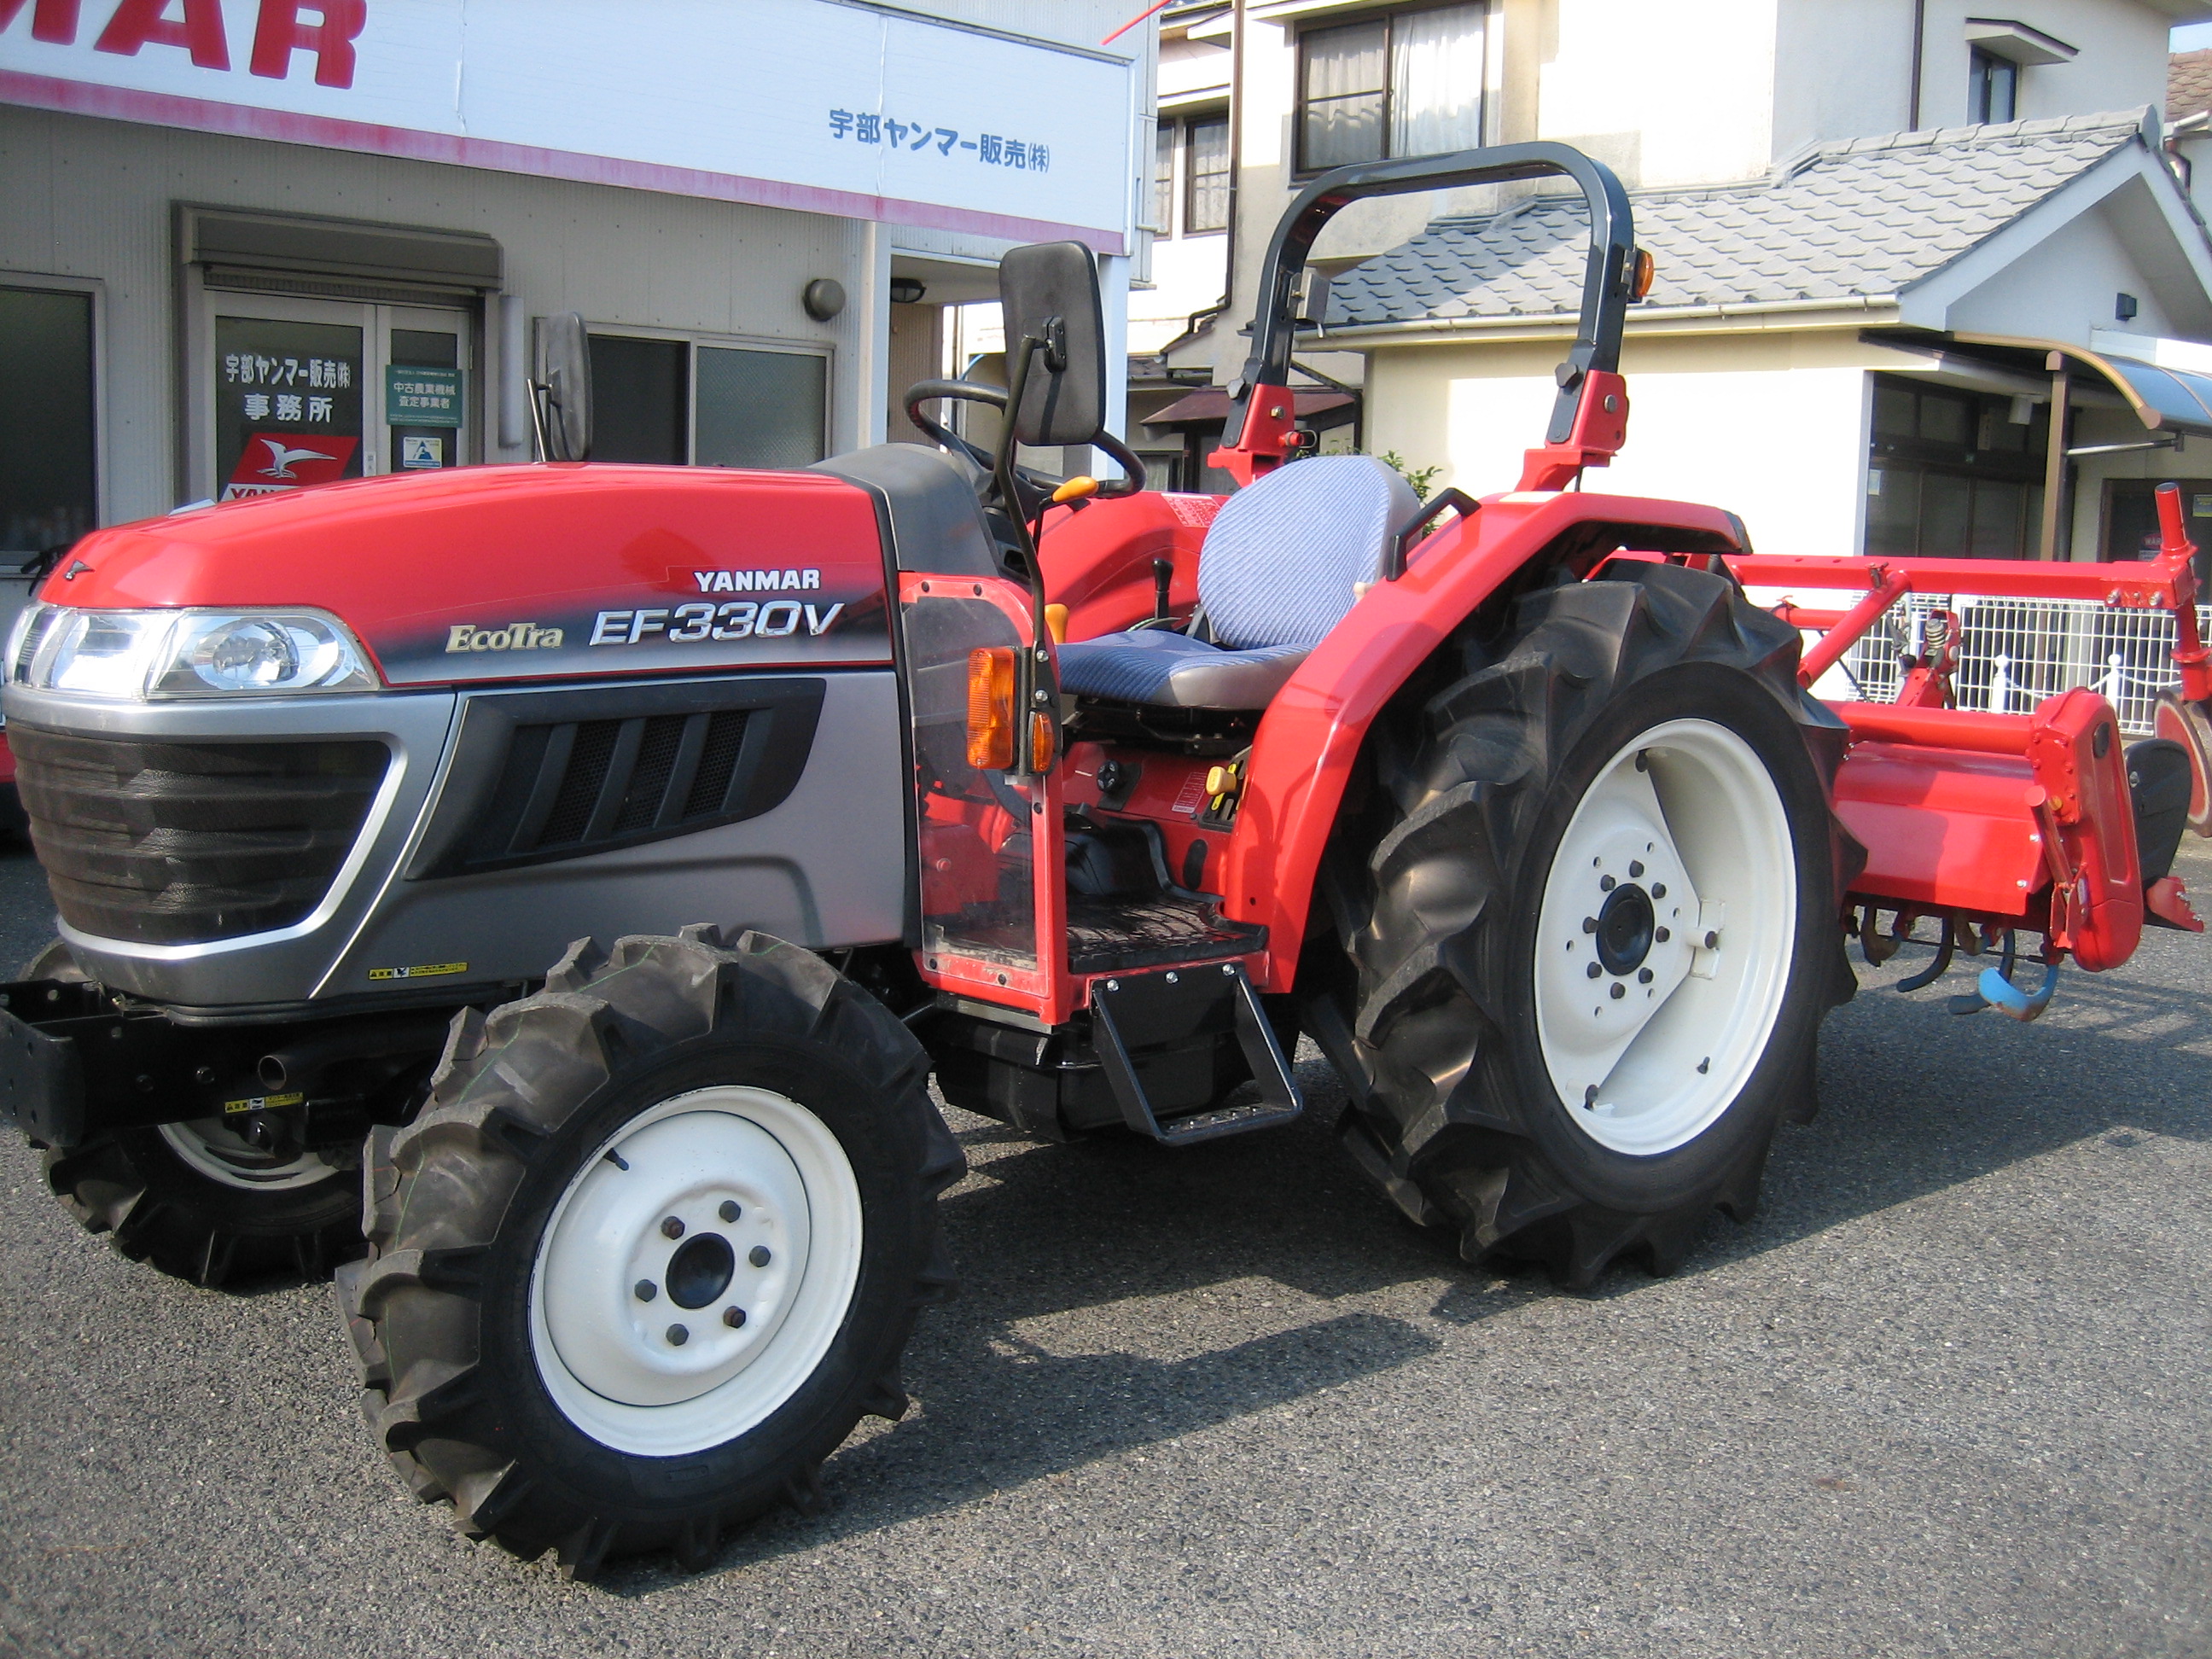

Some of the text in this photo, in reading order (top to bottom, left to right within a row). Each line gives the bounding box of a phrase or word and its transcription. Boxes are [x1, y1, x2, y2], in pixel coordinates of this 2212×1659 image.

[0, 0, 367, 90] AR
[244, 393, 334, 422] 事務所
[693, 568, 822, 593] YANMAR
[445, 622, 564, 654] EcoTra
[589, 600, 845, 647] EF330V
